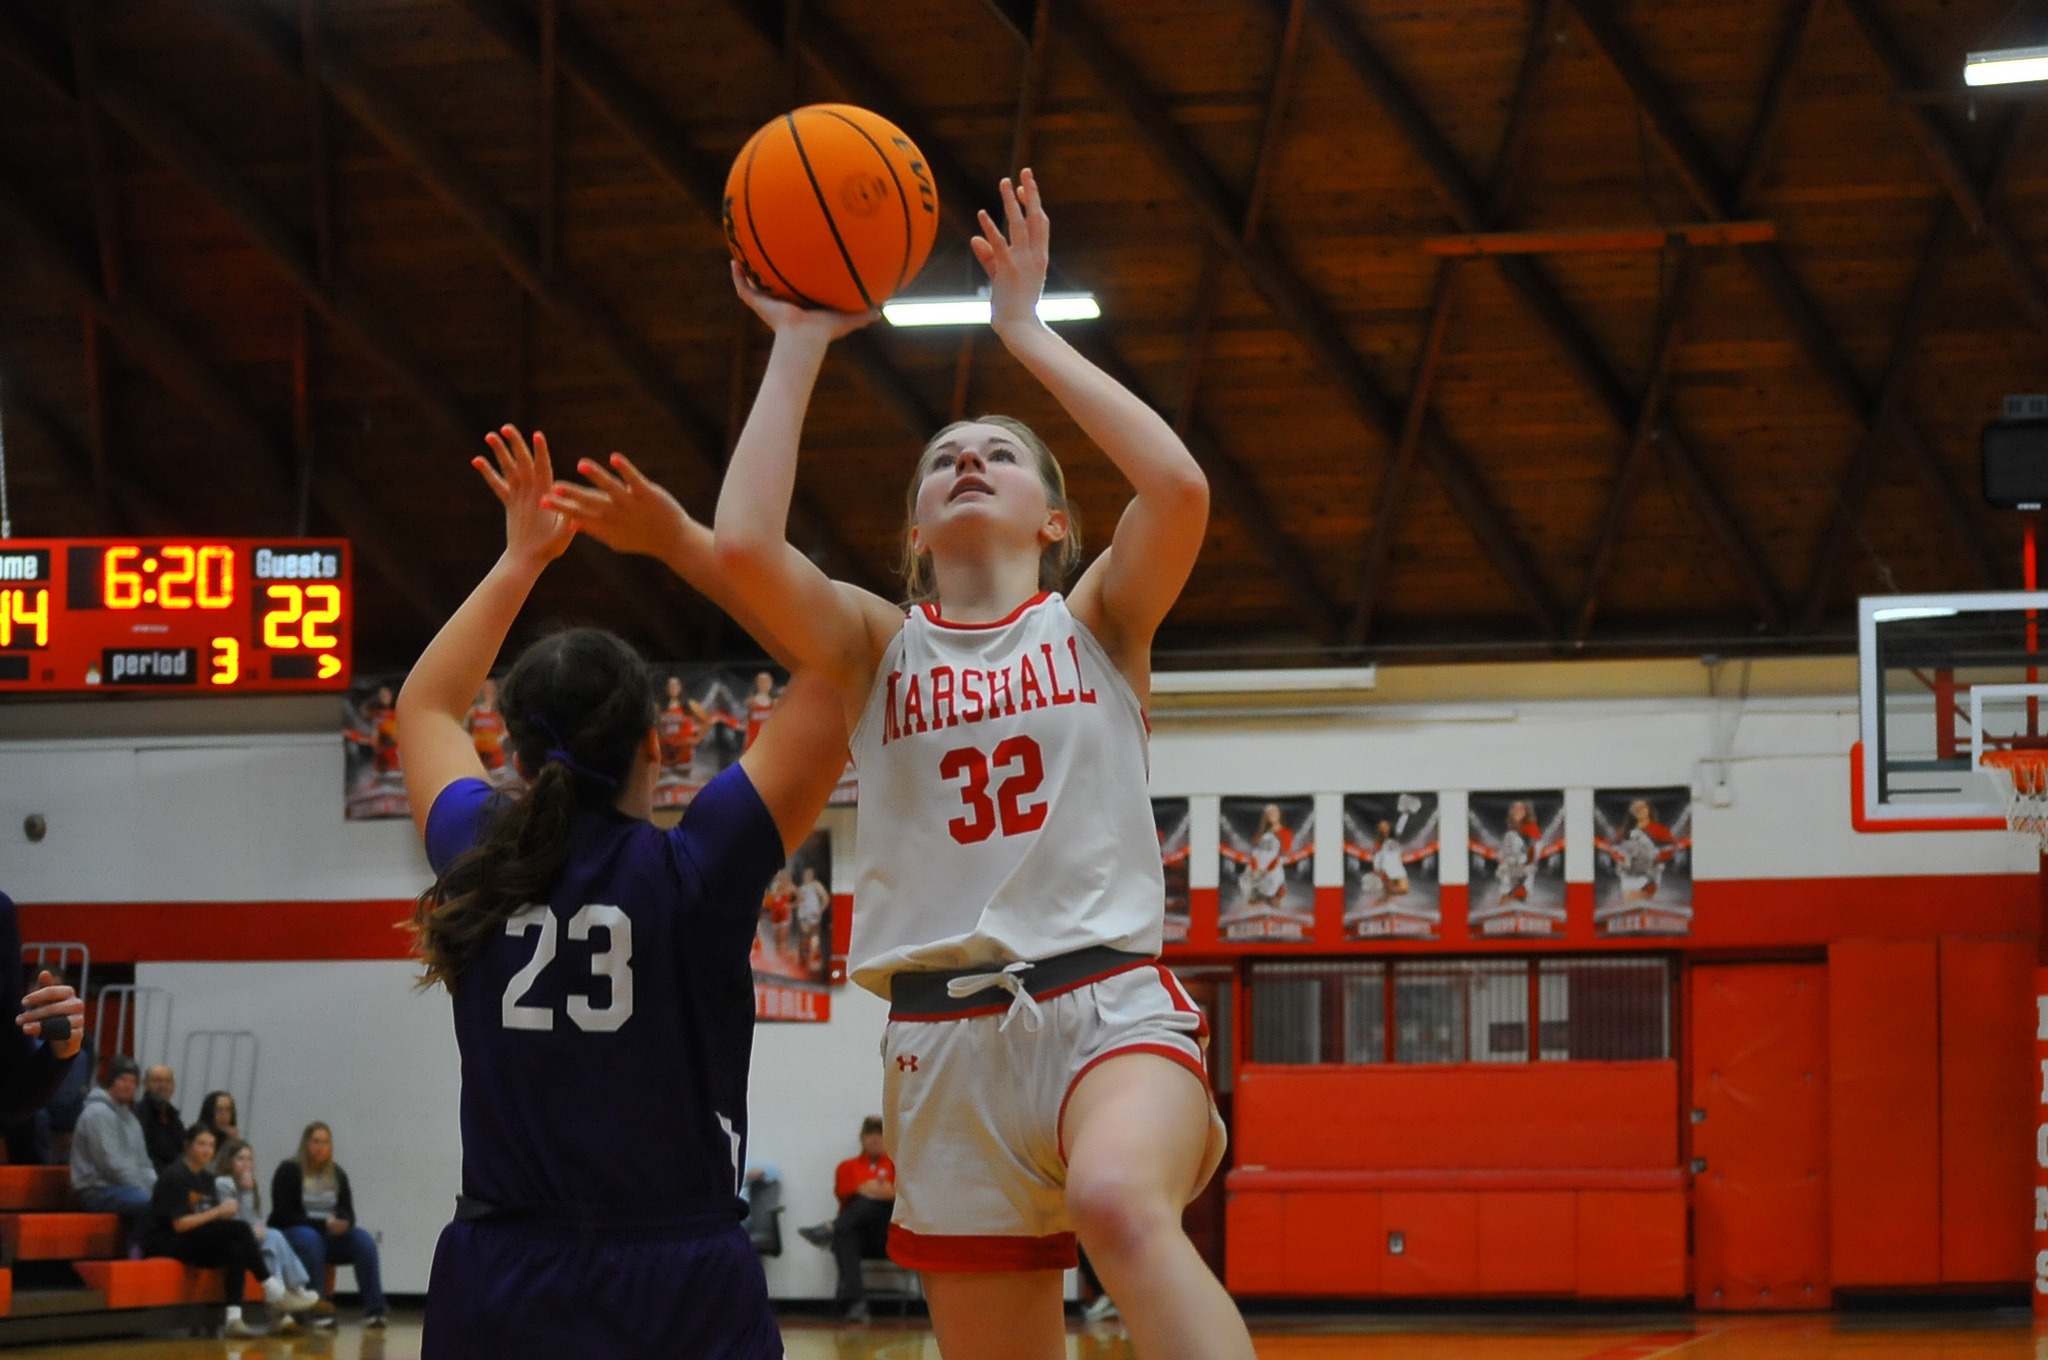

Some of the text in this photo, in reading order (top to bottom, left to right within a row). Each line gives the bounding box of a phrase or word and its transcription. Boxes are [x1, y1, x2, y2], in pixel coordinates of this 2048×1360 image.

[0, 555, 38, 580] me
[104, 545, 234, 609] 6:20
[256, 548, 337, 579] Guests
[263, 585, 341, 649] 22
[112, 649, 187, 680] period
[211, 637, 239, 685] 3
[883, 635, 1097, 745] MARSHALL
[939, 734, 1048, 845] 32
[502, 904, 634, 1032] 23
